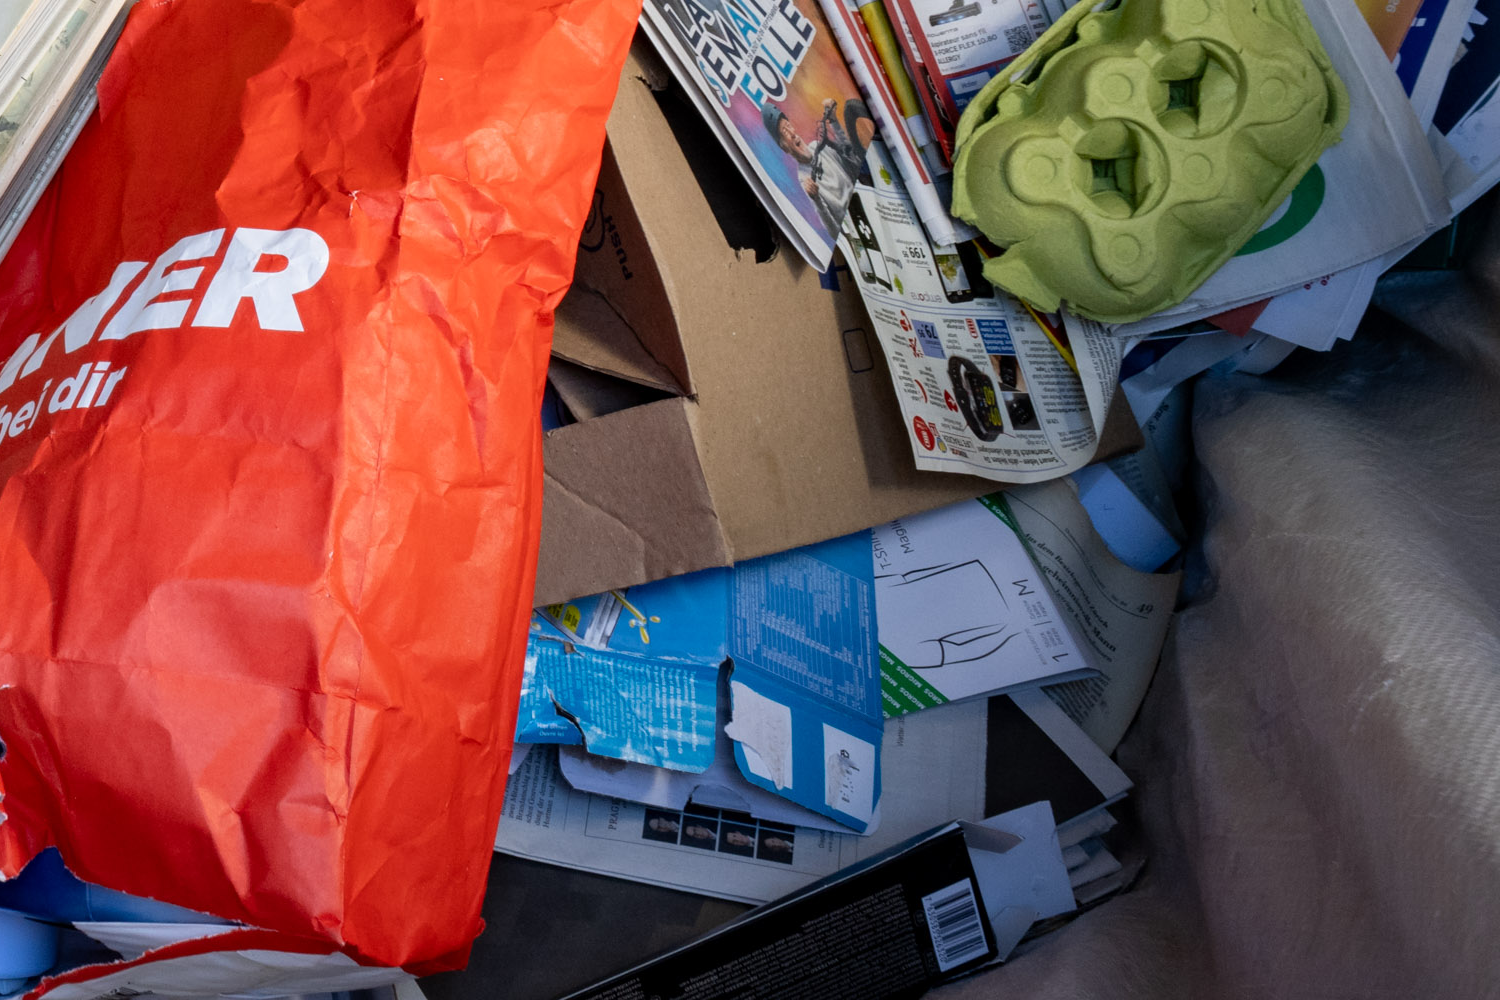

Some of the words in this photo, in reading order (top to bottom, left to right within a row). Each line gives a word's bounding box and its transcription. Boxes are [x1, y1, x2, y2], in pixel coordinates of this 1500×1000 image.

[958, 40, 974, 50] FLEX
[603, 215, 633, 279] PUSH
[47, 361, 128, 412] dir
[1011, 578, 1034, 596] M
[896, 665, 922, 687] MIGROS
[899, 687, 926, 709] MIGROS
